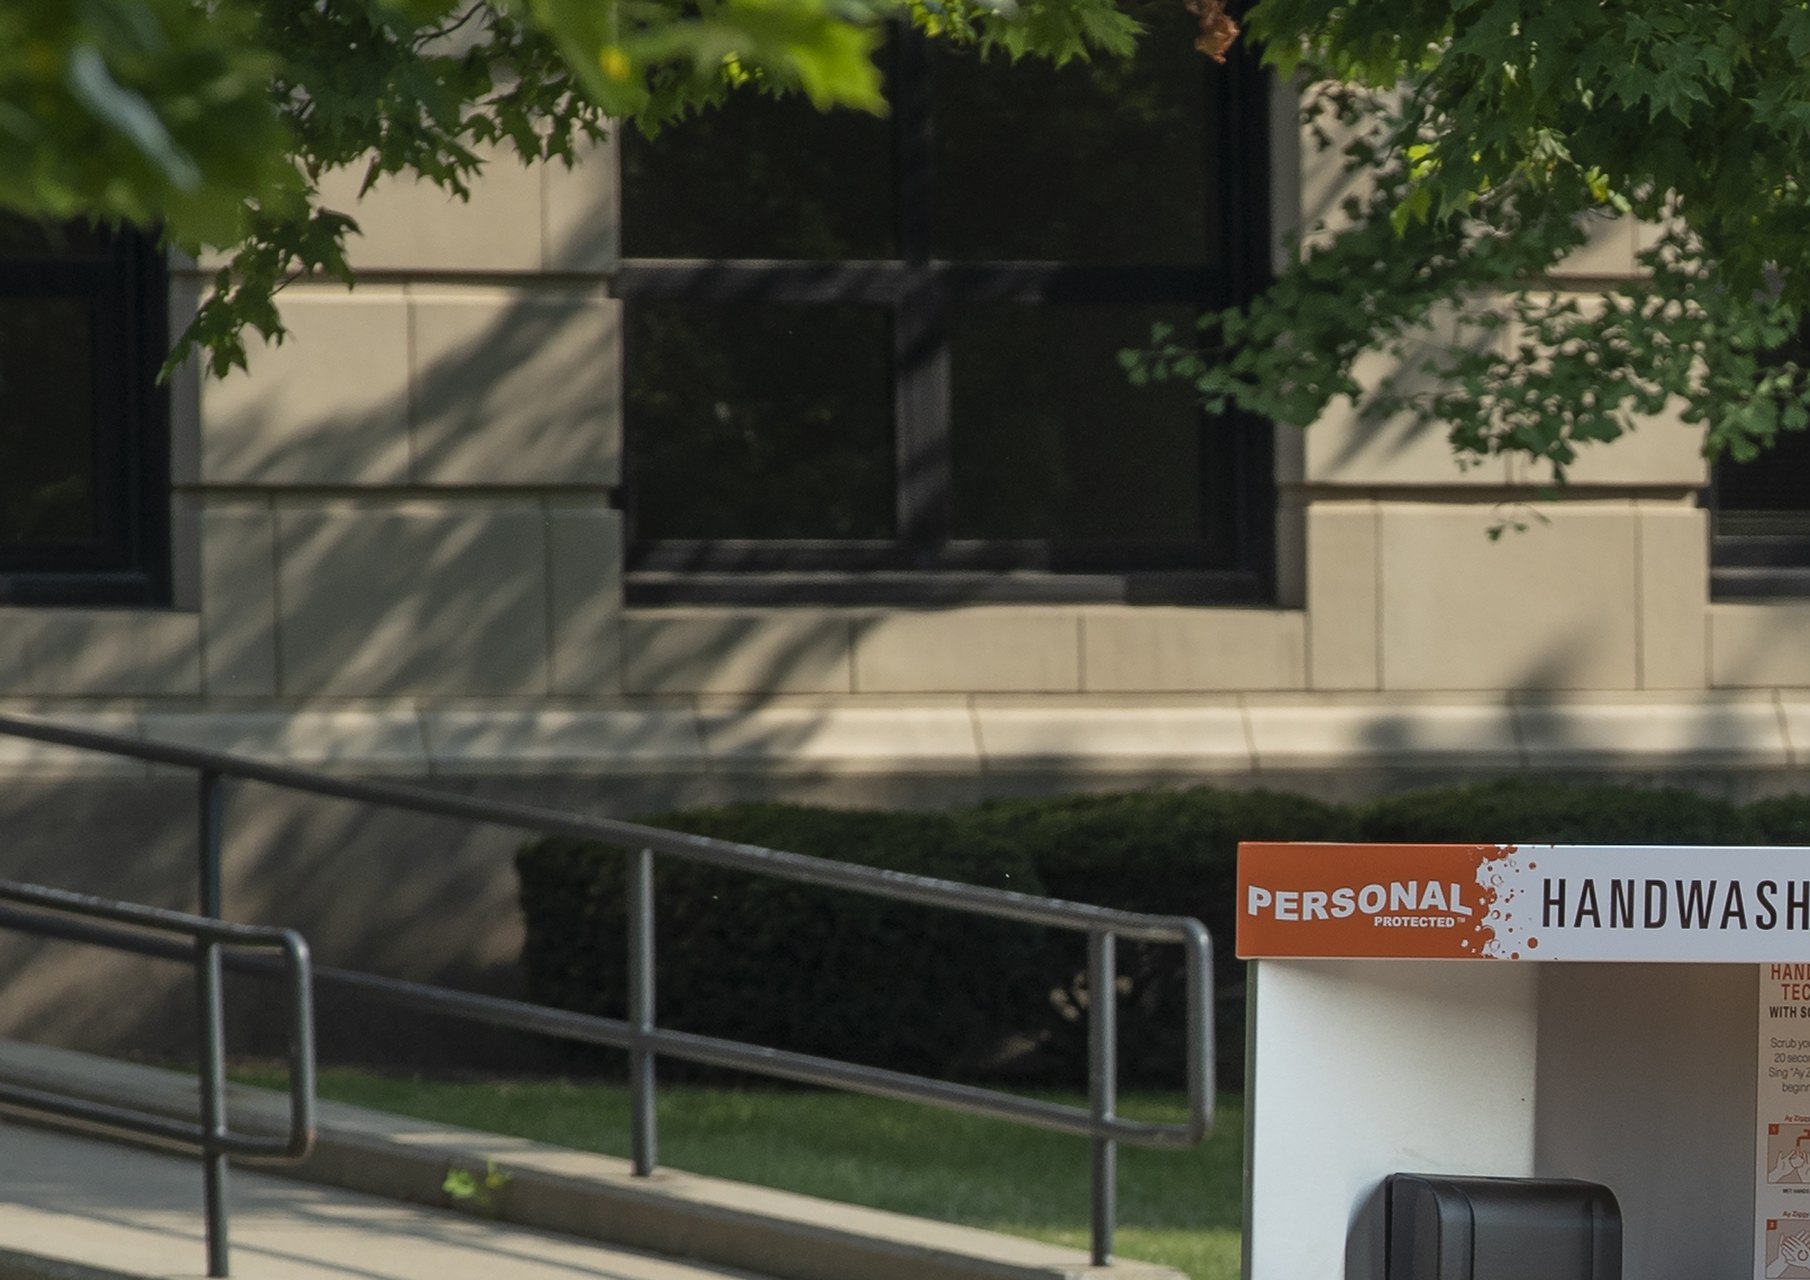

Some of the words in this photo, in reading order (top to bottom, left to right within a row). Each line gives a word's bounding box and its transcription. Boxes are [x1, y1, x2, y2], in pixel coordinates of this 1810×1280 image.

[1248, 881, 1472, 922] PERSONAL
[1769, 1006, 1797, 1018] WITH
[1770, 1038, 1797, 1048] Scrub
[1774, 1053, 1786, 1063] 20
[1768, 1067, 1788, 1080] Sing
